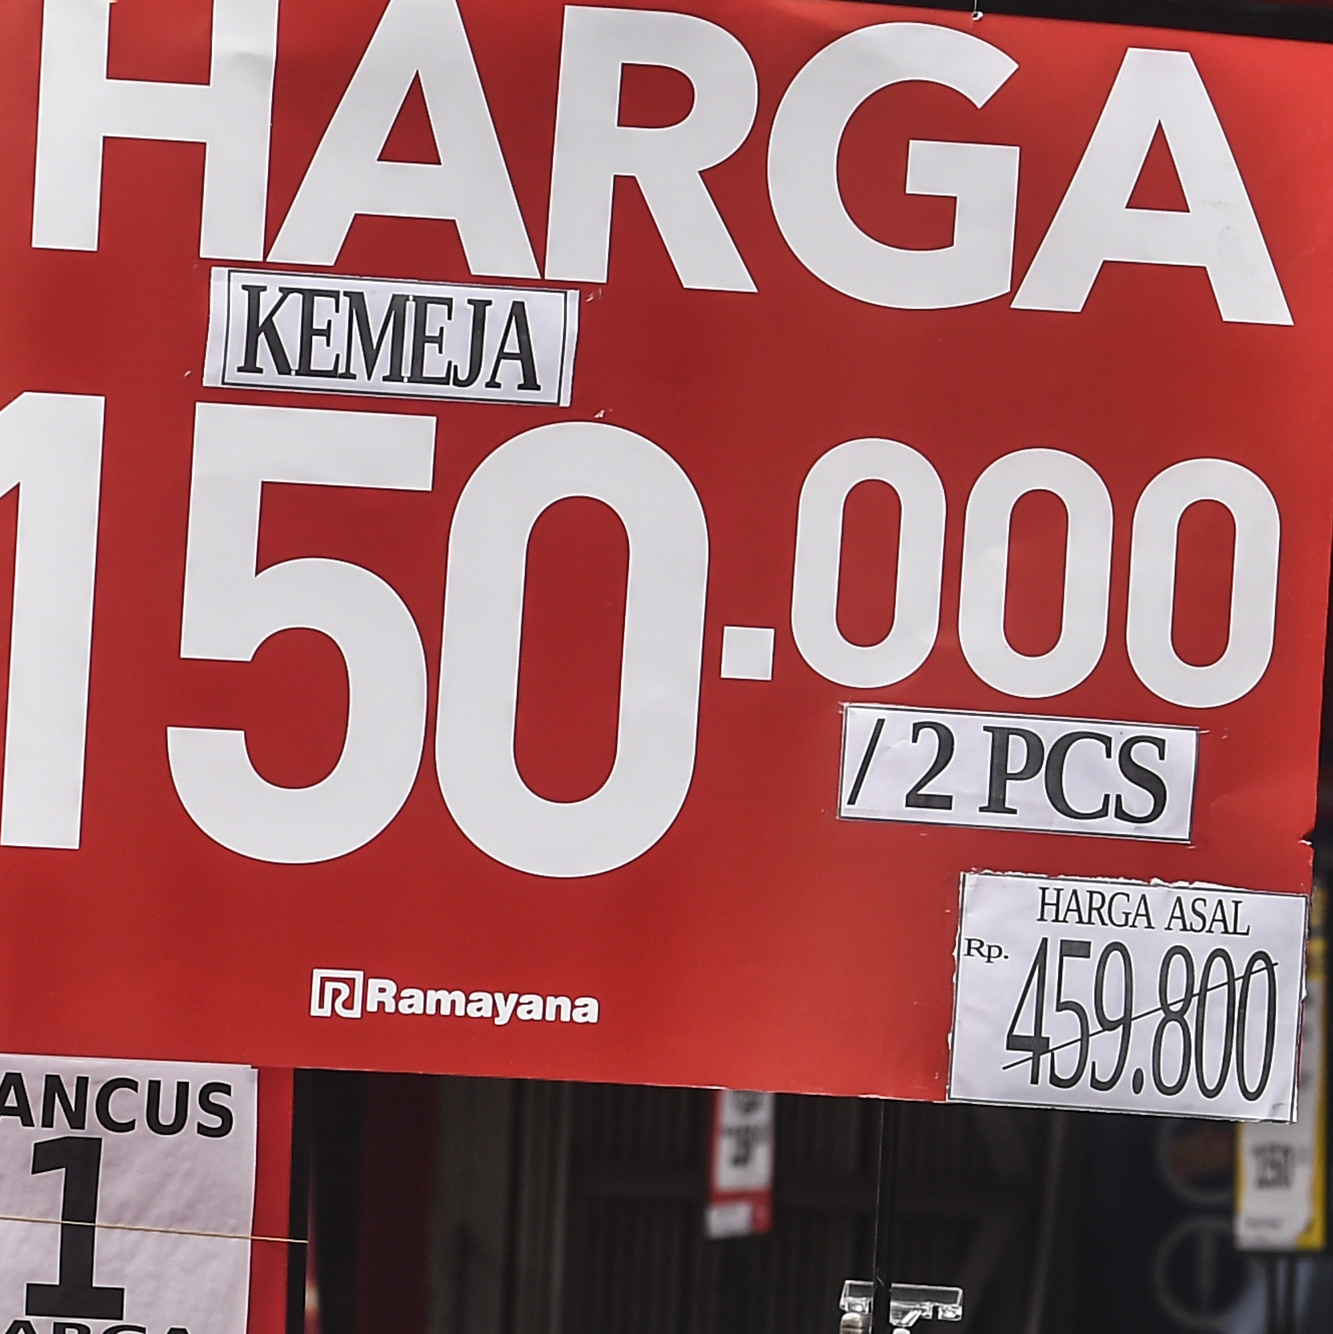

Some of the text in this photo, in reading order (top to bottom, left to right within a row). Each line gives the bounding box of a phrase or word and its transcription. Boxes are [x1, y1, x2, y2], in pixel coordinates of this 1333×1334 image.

[32, 0, 1294, 326] HARGA
[237, 284, 541, 391] KEMEJA
[980, 725, 1168, 824] PCS
[1038, 886, 1251, 937] HARGA ASAL
[367, 979, 599, 1026] Ramayana
[964, 937, 1278, 1101] Rp. 459.800
[25, 1136, 124, 1320] 1
